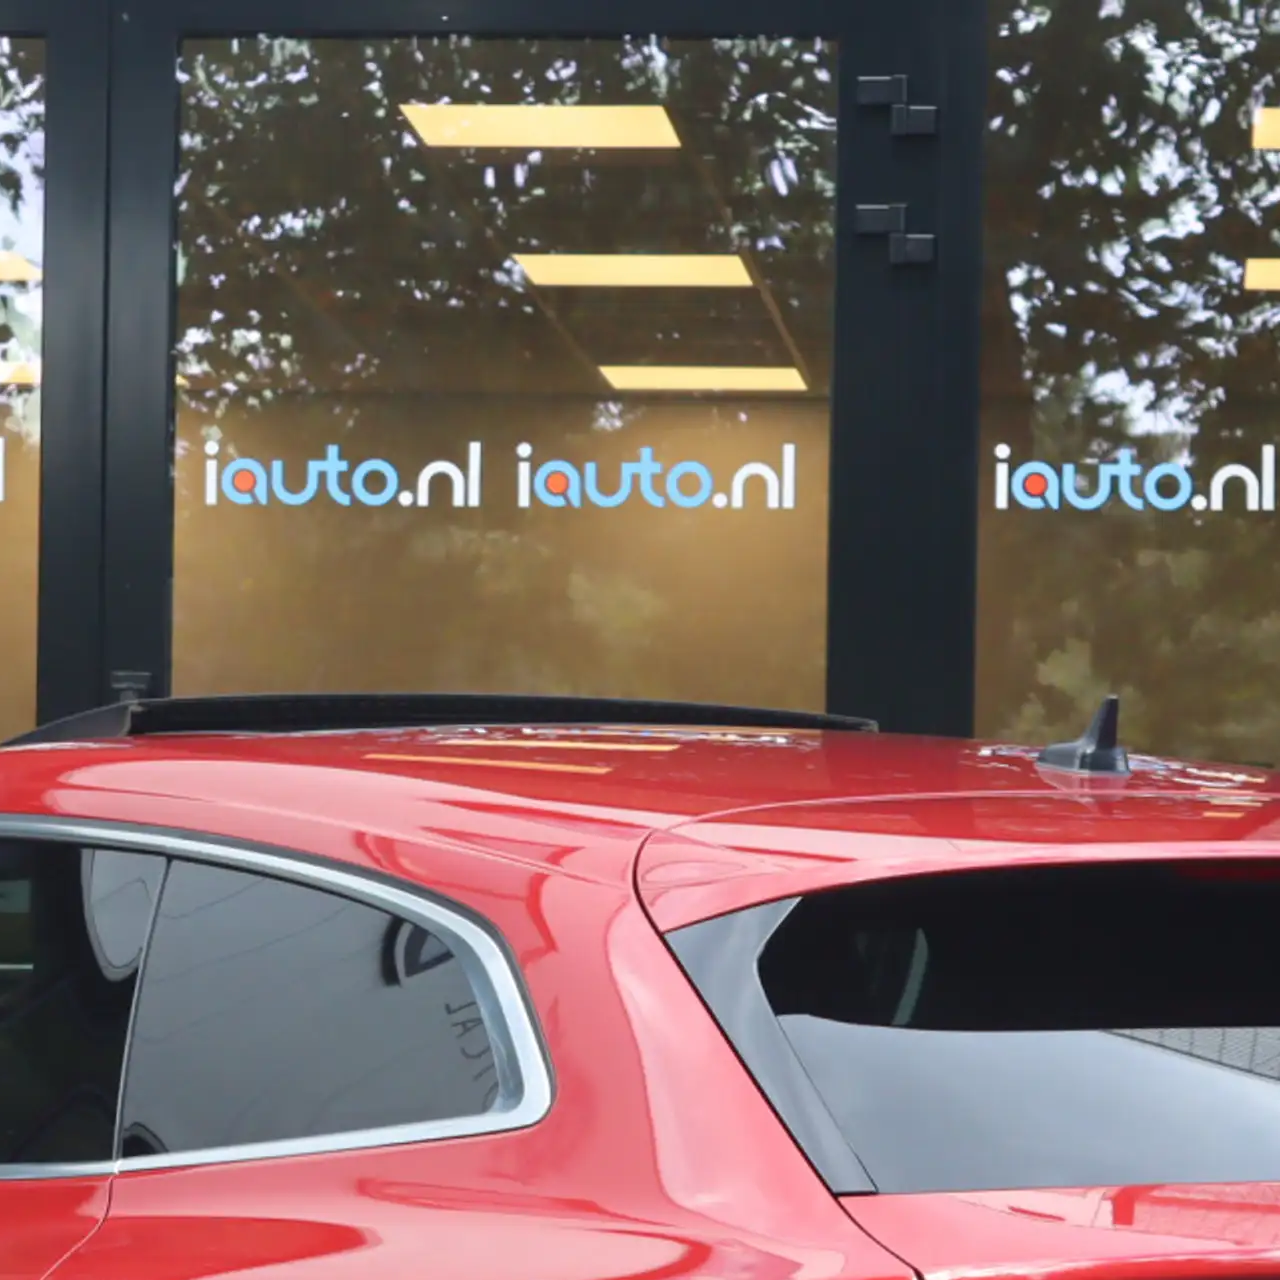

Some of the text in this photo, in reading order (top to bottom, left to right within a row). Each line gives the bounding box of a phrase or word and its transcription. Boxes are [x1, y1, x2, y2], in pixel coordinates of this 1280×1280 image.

[204, 440, 796, 509] iauto.nl iauto.nl
[995, 443, 1275, 511] iauto.nl
